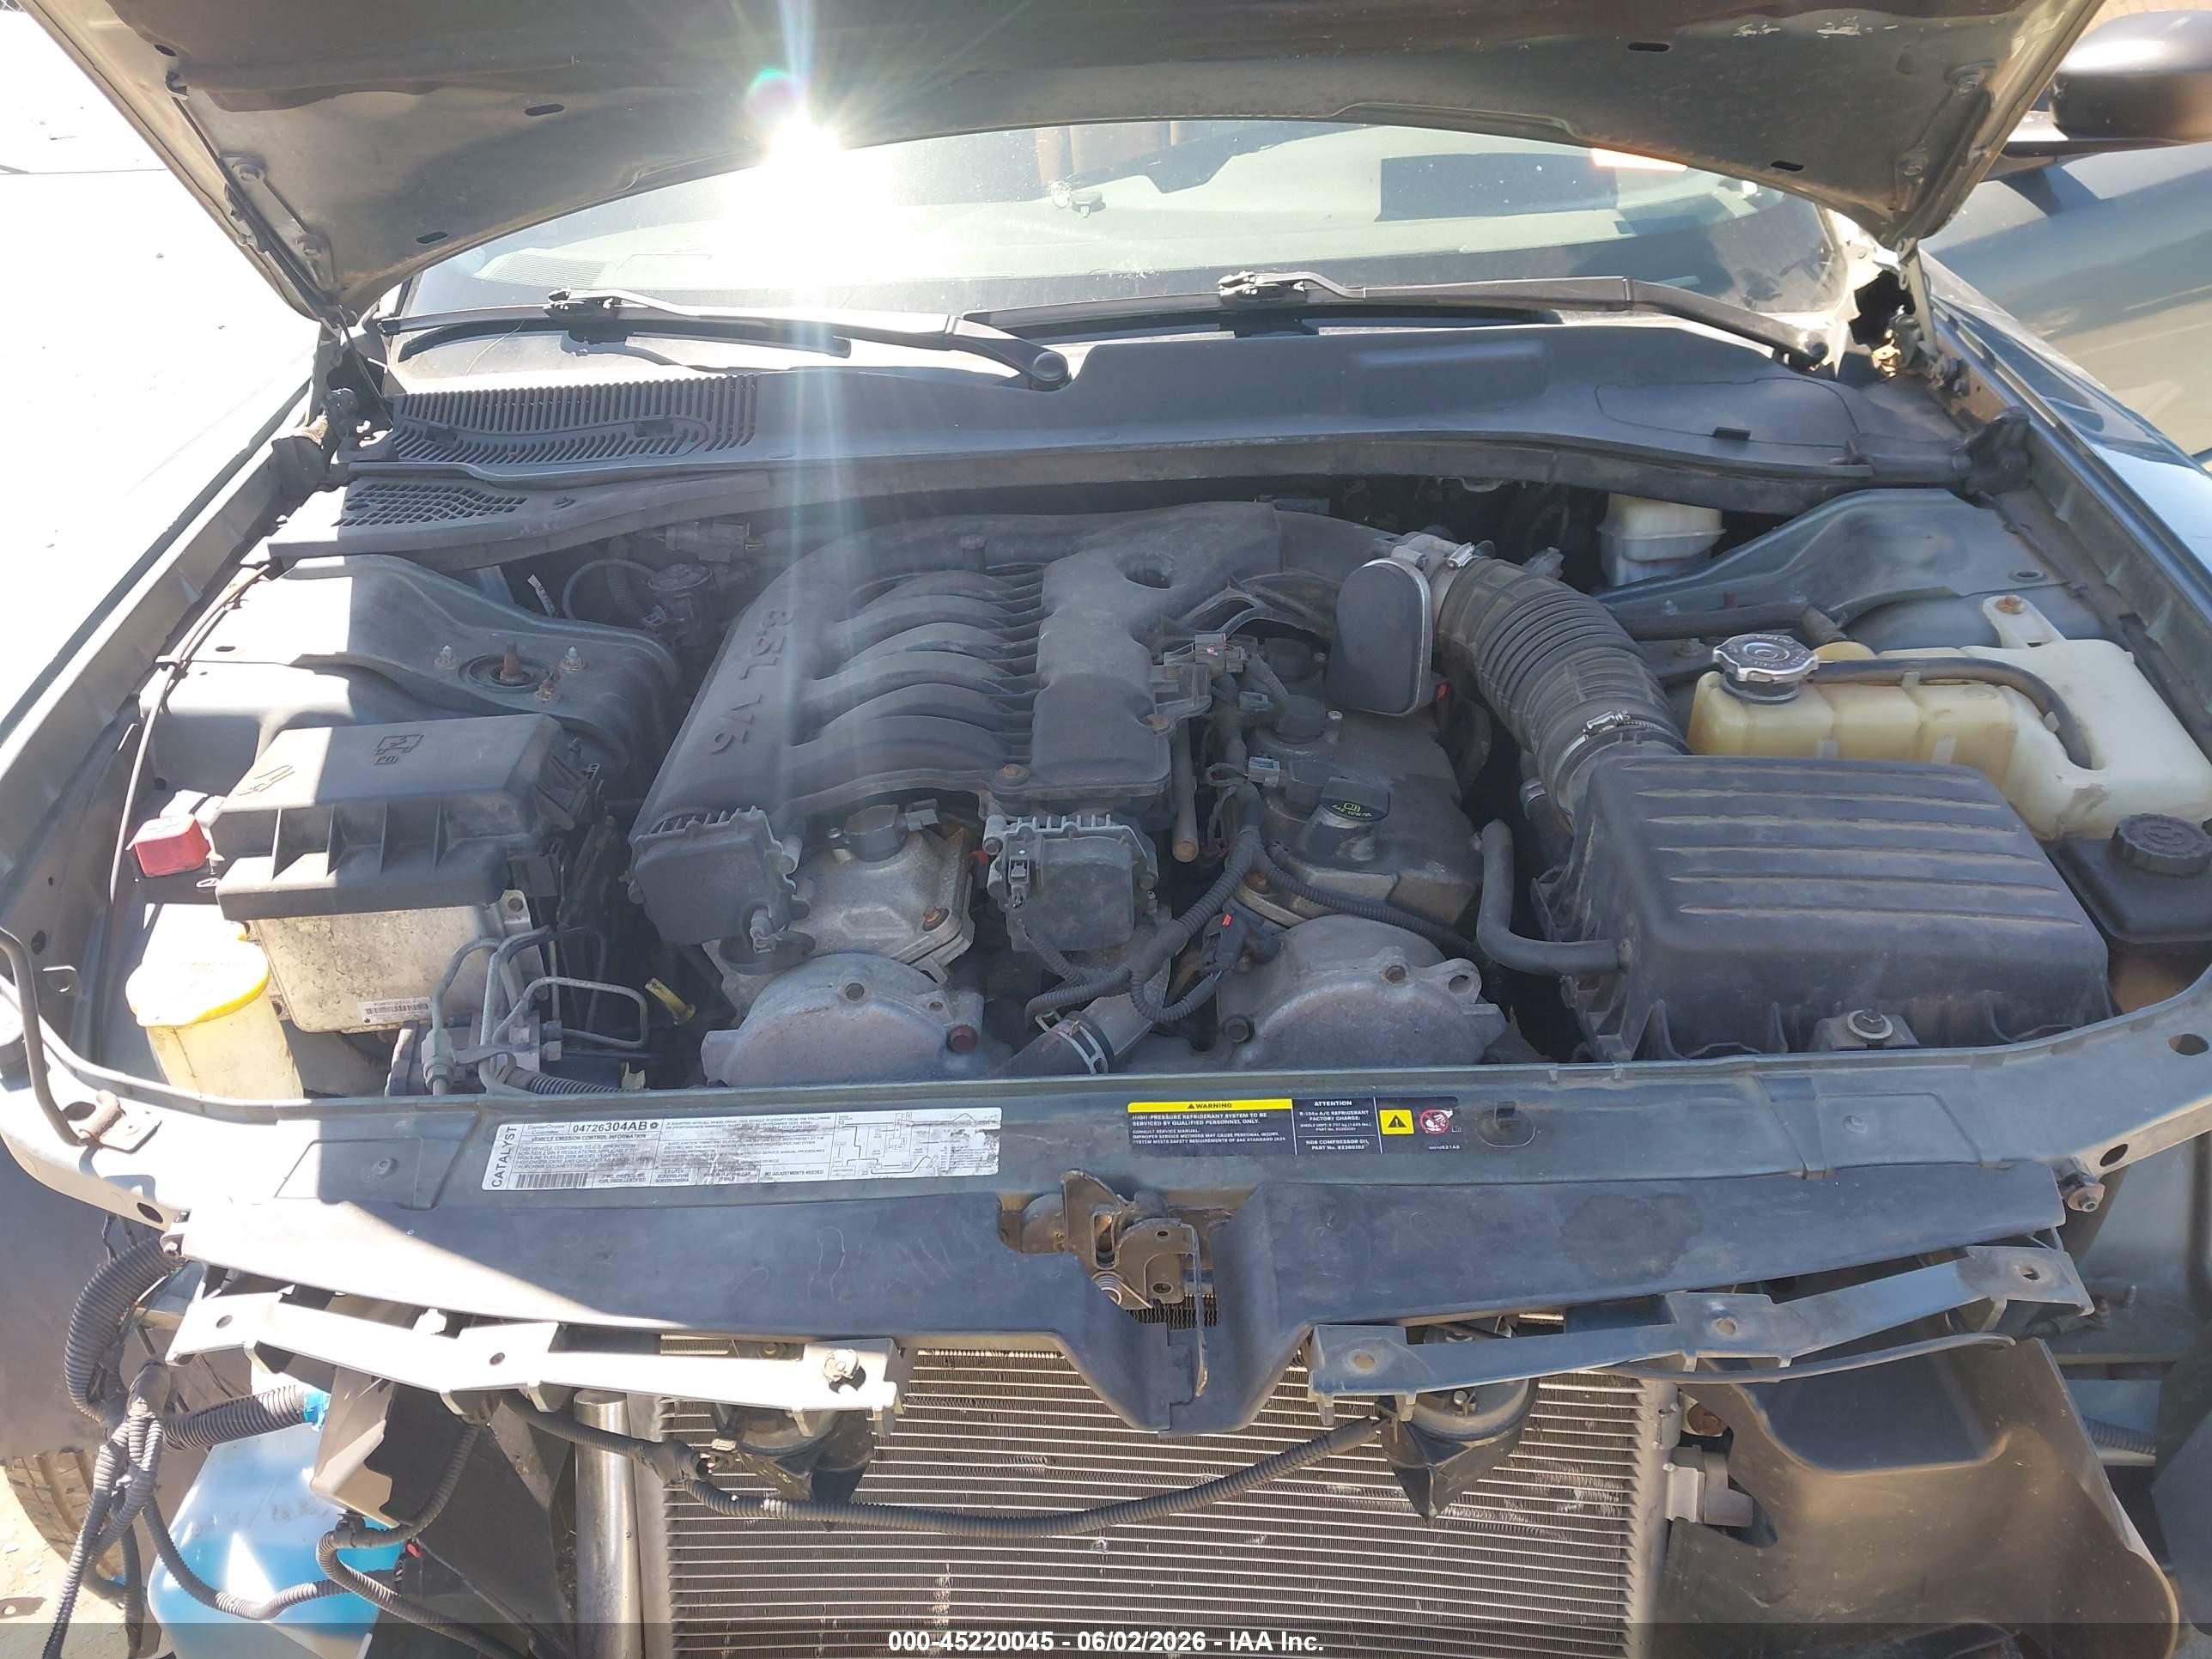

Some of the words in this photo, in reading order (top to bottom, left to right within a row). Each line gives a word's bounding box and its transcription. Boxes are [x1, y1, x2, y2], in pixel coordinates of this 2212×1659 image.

[740, 611, 794, 680] 3.5L
[710, 694, 763, 755] V6
[491, 1127, 517, 1188] CATALYST
[573, 1121, 647, 1133] 04726304AB
